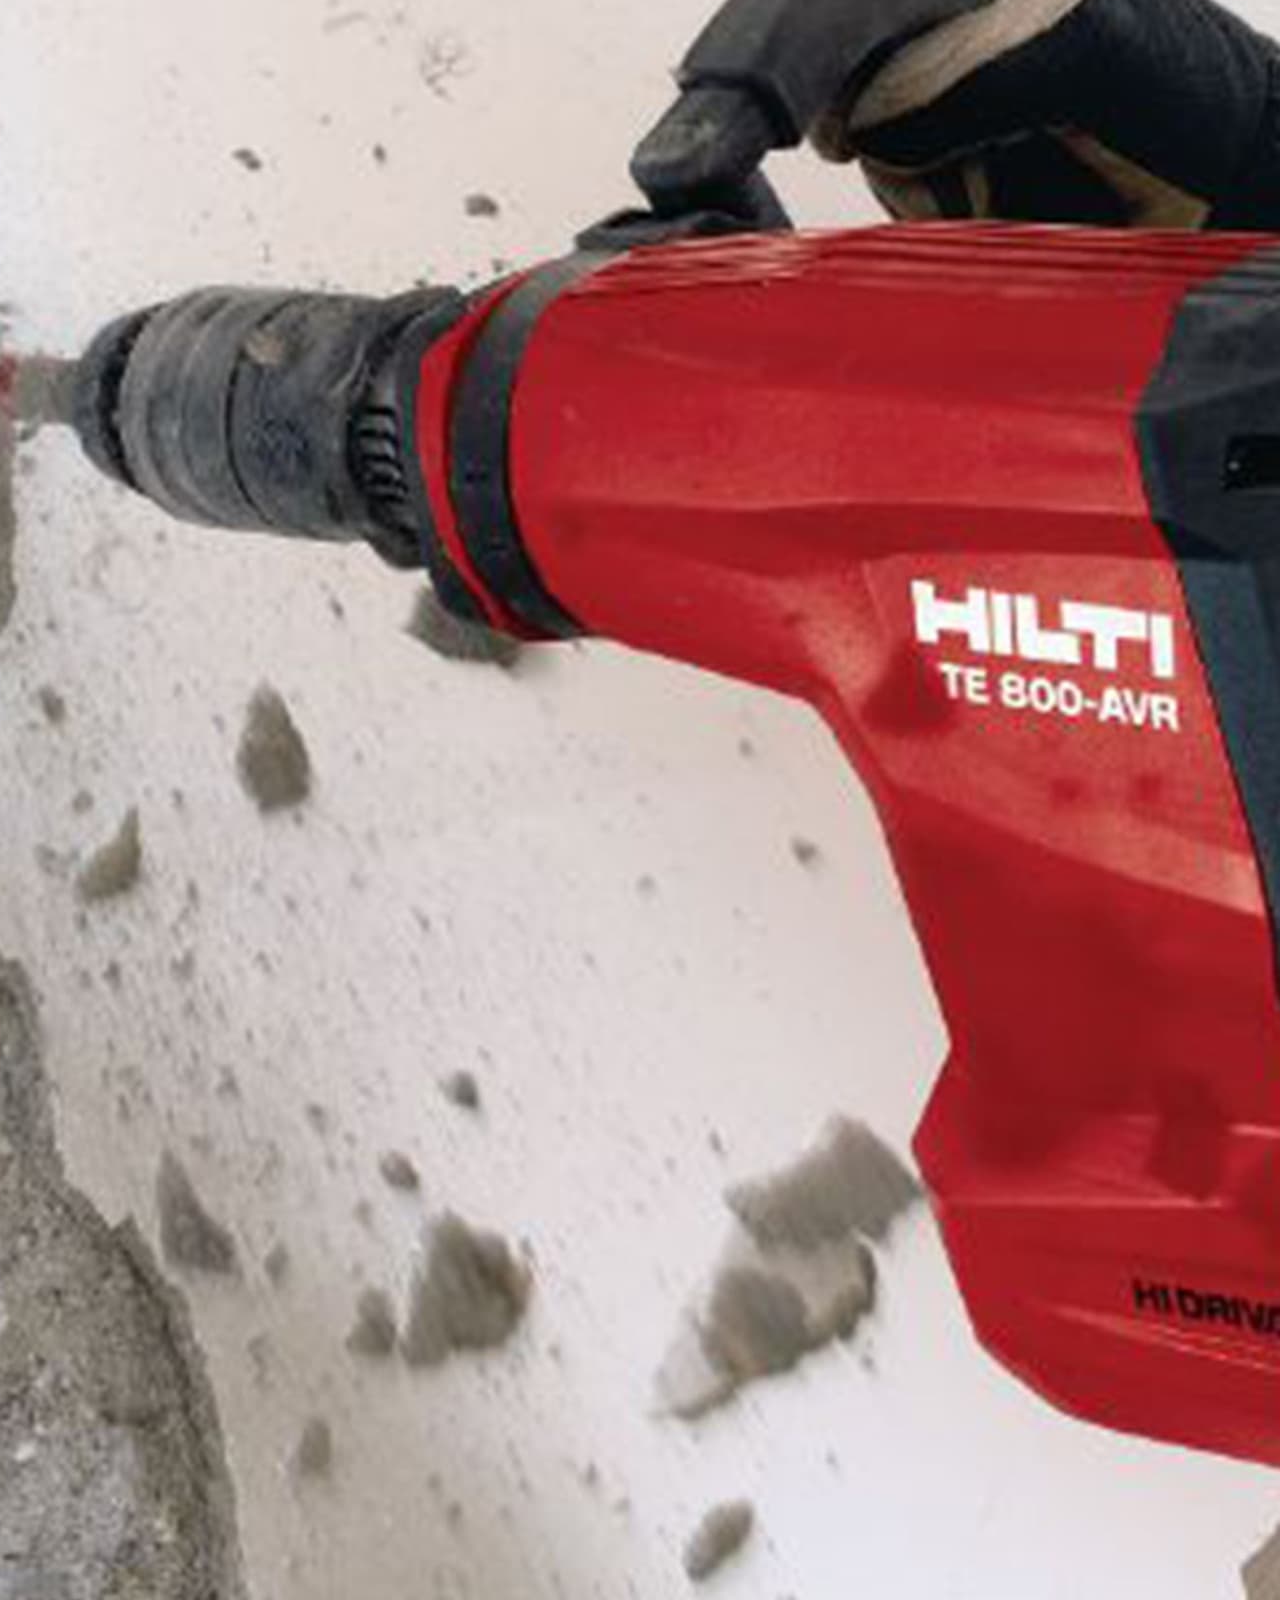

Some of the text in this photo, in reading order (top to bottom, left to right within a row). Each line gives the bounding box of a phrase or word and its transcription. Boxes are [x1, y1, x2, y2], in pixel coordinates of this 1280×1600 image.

[910, 580, 1175, 679] HILTI
[938, 662, 1181, 732] TE 800-AVR
[1133, 1281, 1170, 1316] HI
